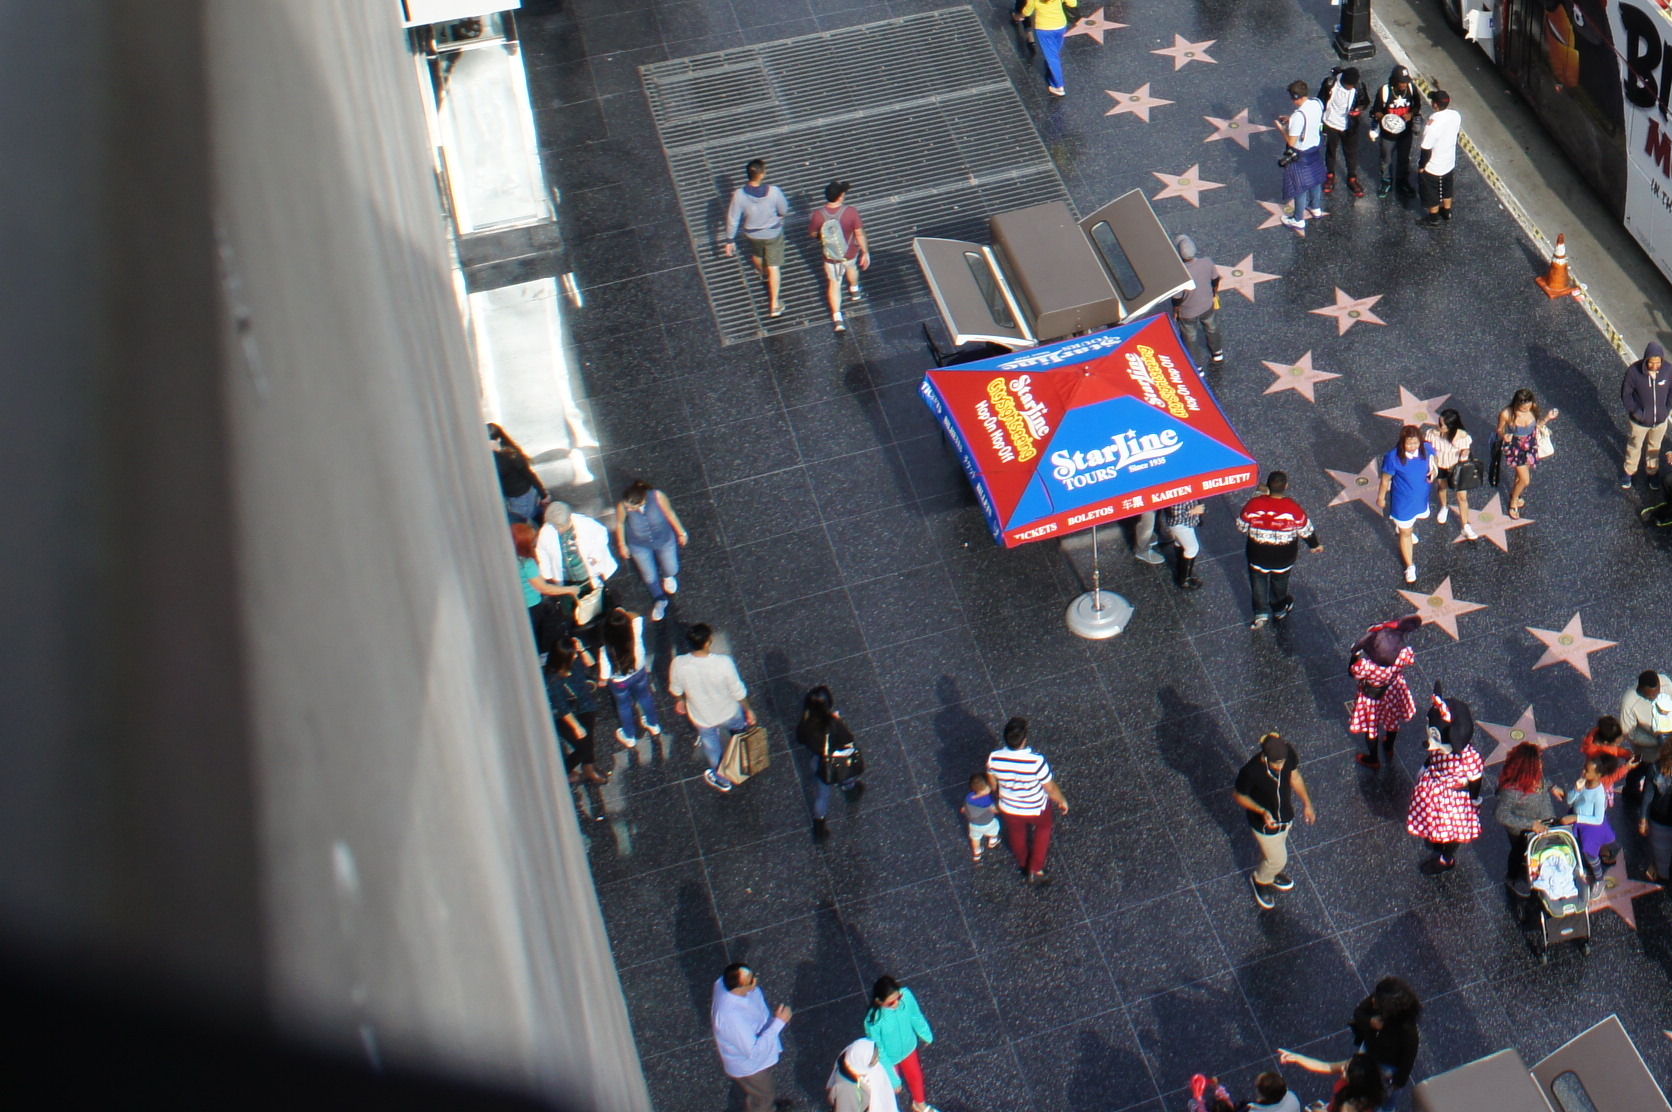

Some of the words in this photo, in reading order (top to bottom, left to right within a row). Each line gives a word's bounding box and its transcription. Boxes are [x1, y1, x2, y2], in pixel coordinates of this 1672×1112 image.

[1651, 180, 1659, 198] IN
[1158, 354, 1174, 374] Off
[1169, 366, 1186, 388] Hop
[1177, 379, 1192, 396] On
[975, 400, 990, 421] Hop
[1183, 390, 1200, 411] Hop
[984, 416, 997, 433] On
[990, 429, 1005, 450] Hop
[998, 445, 1015, 464] Off
[1063, 466, 1117, 490] TOURS
[1129, 462, 1148, 473] Since
[1149, 457, 1166, 467] 1935
[1152, 485, 1192, 503] KARTEN
[1202, 473, 1250, 491] BIGLIETTI
[1014, 523, 1057, 540] TICKETS
[1068, 506, 1114, 526] BOLETOS
